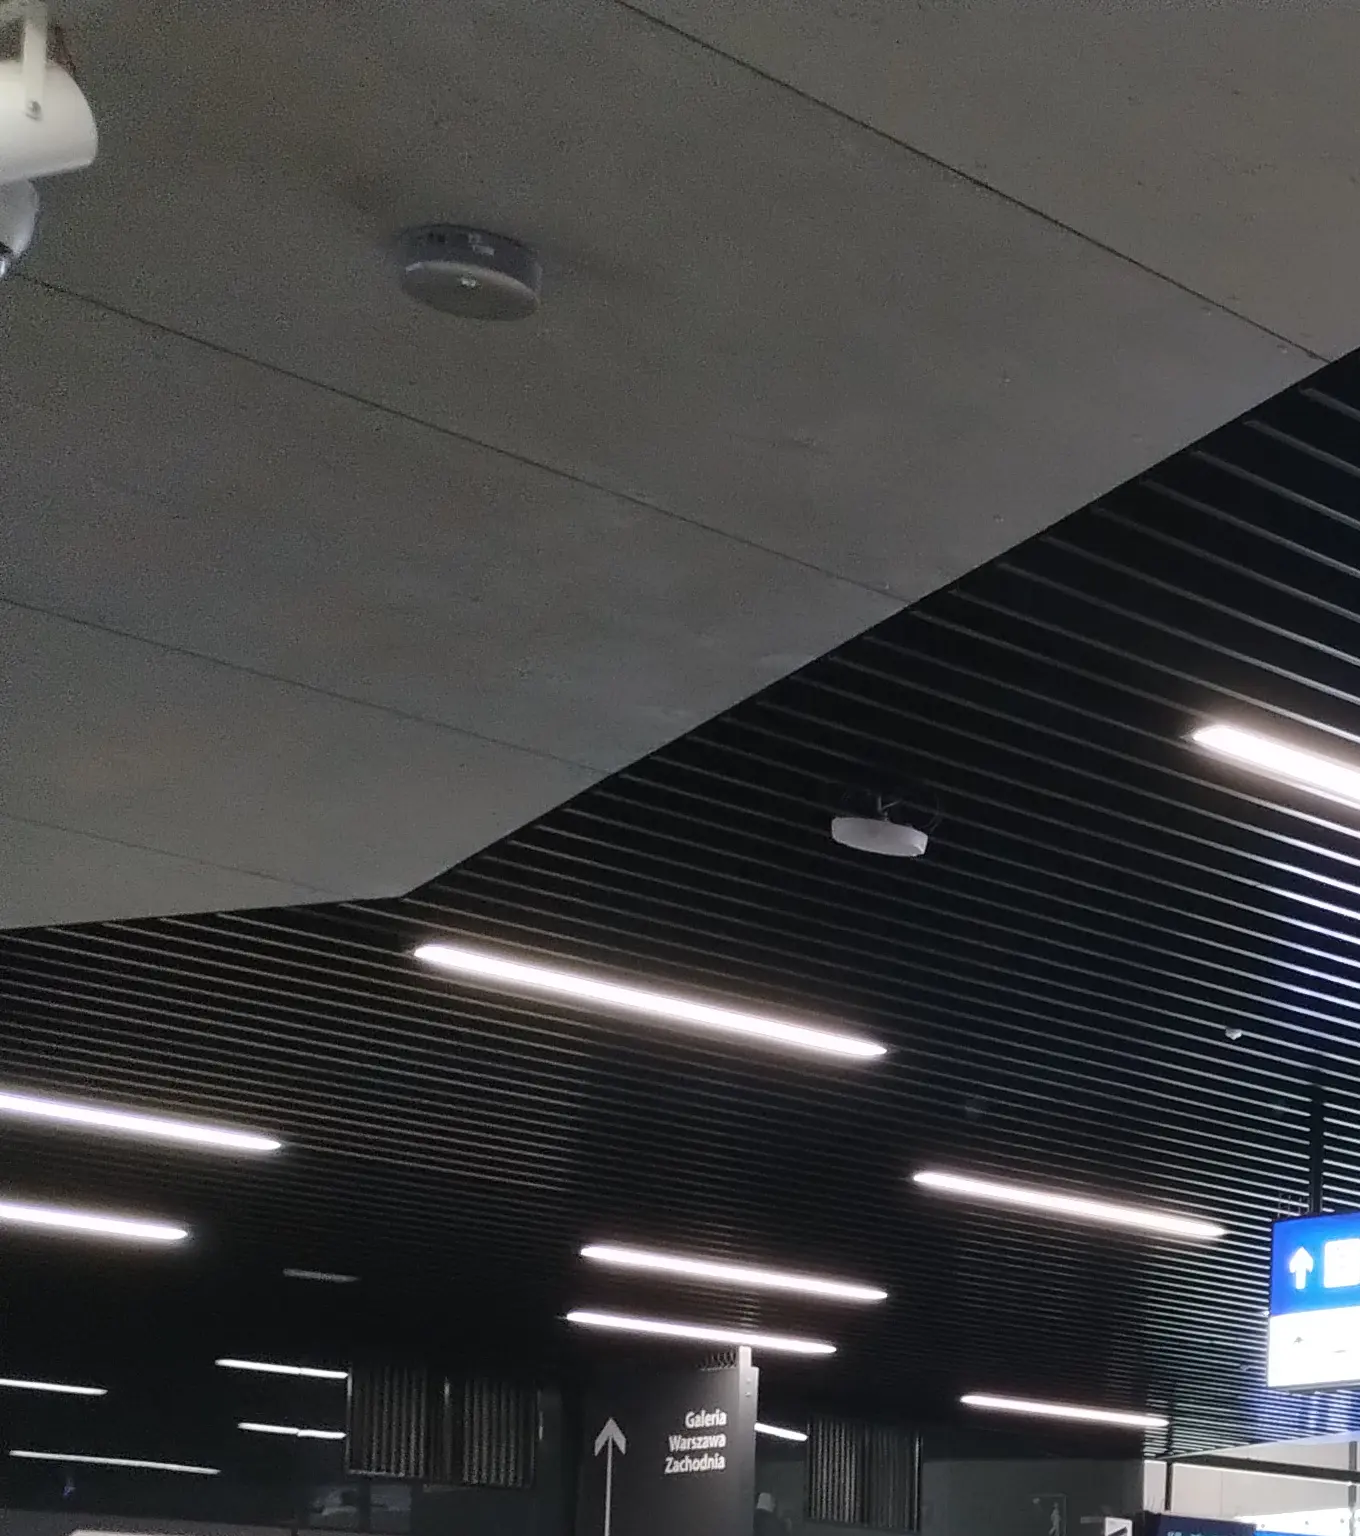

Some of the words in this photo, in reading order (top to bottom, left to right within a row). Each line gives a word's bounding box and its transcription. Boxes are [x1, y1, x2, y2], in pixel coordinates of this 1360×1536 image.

[684, 1408, 728, 1429] Galeria
[668, 1433, 727, 1452] Warszawa
[664, 1452, 726, 1474] Zachodnia
